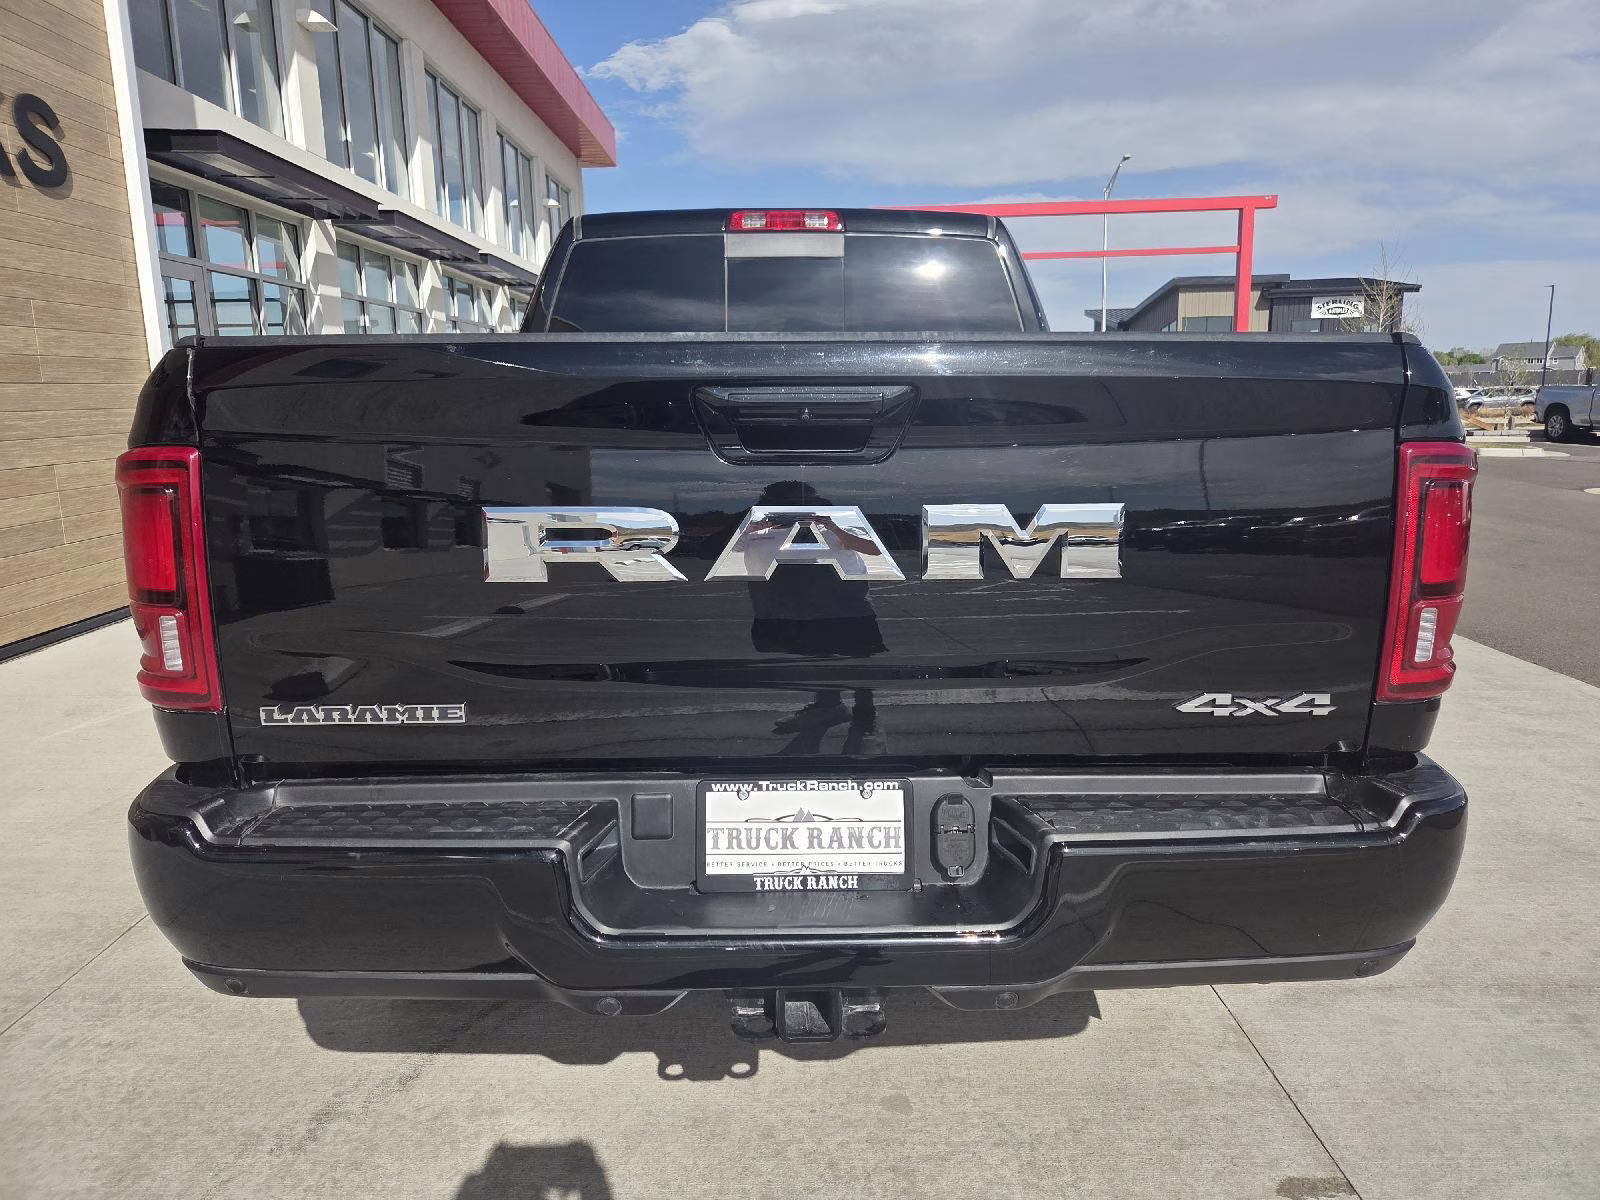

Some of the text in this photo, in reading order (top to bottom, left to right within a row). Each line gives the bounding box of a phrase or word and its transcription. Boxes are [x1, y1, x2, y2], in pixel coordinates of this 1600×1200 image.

[1317, 299, 1359, 309] STERLING
[482, 503, 1126, 583] RAM
[259, 702, 467, 726] LARAMIE
[711, 780, 899, 792] www.TruckRanch.com
[707, 826, 902, 851] TRUCK RANCH
[753, 875, 859, 891] TRUCK RANCH
